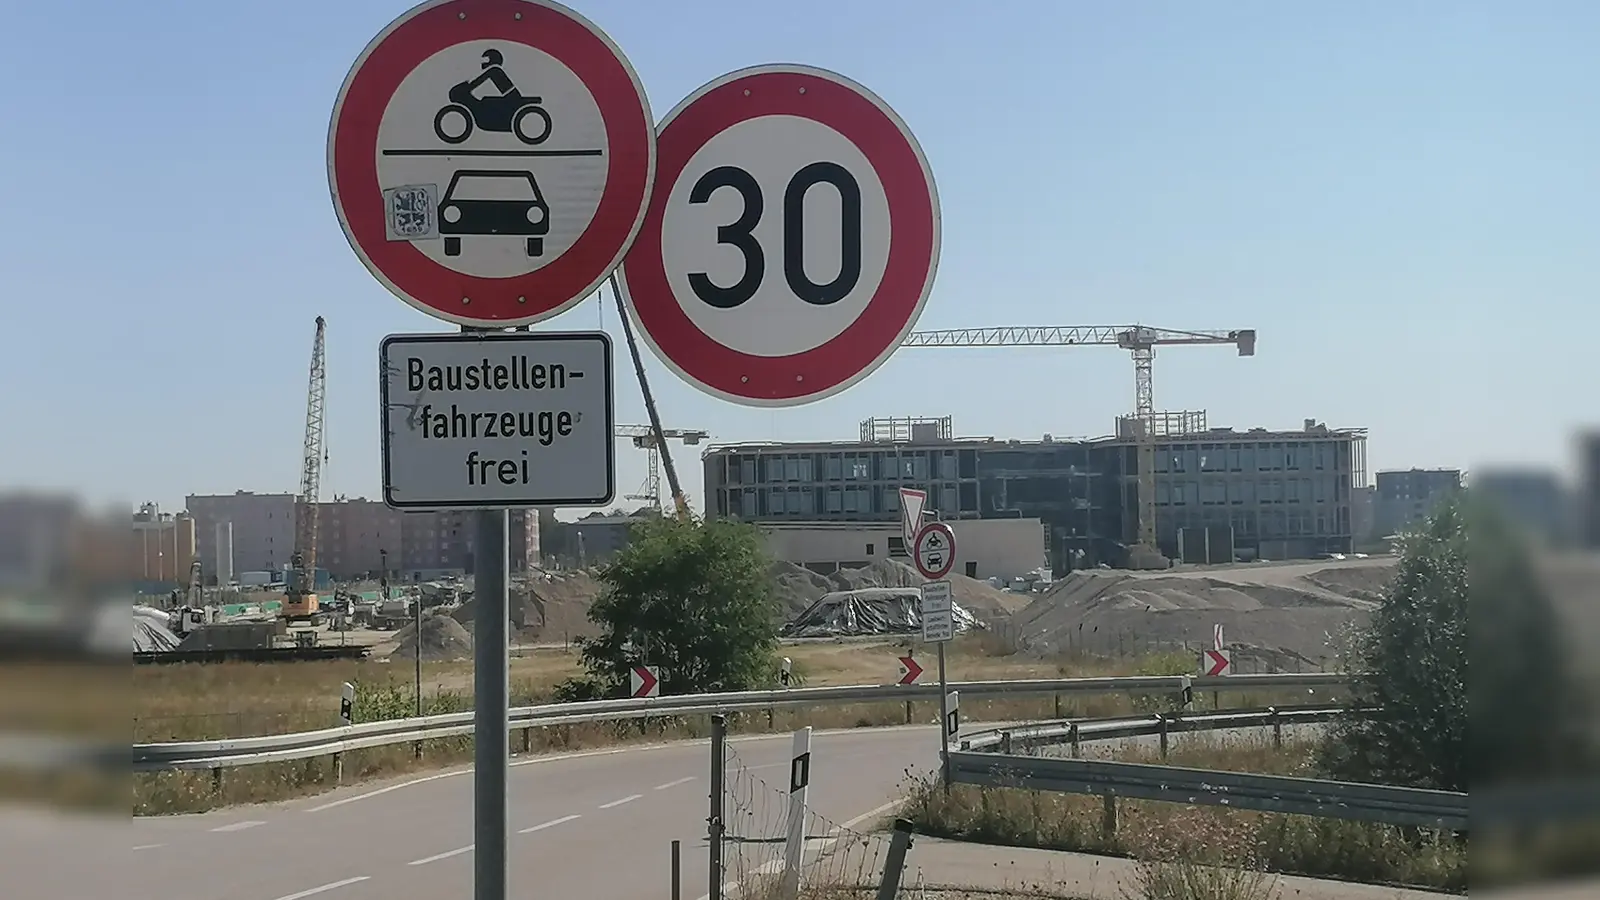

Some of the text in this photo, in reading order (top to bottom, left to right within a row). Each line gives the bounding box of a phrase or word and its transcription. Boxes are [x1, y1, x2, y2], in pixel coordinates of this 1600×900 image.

[687, 161, 861, 309] 30
[407, 355, 584, 391] Baustellen-
[420, 404, 573, 446] fahrzeuge
[465, 450, 530, 485] frei
